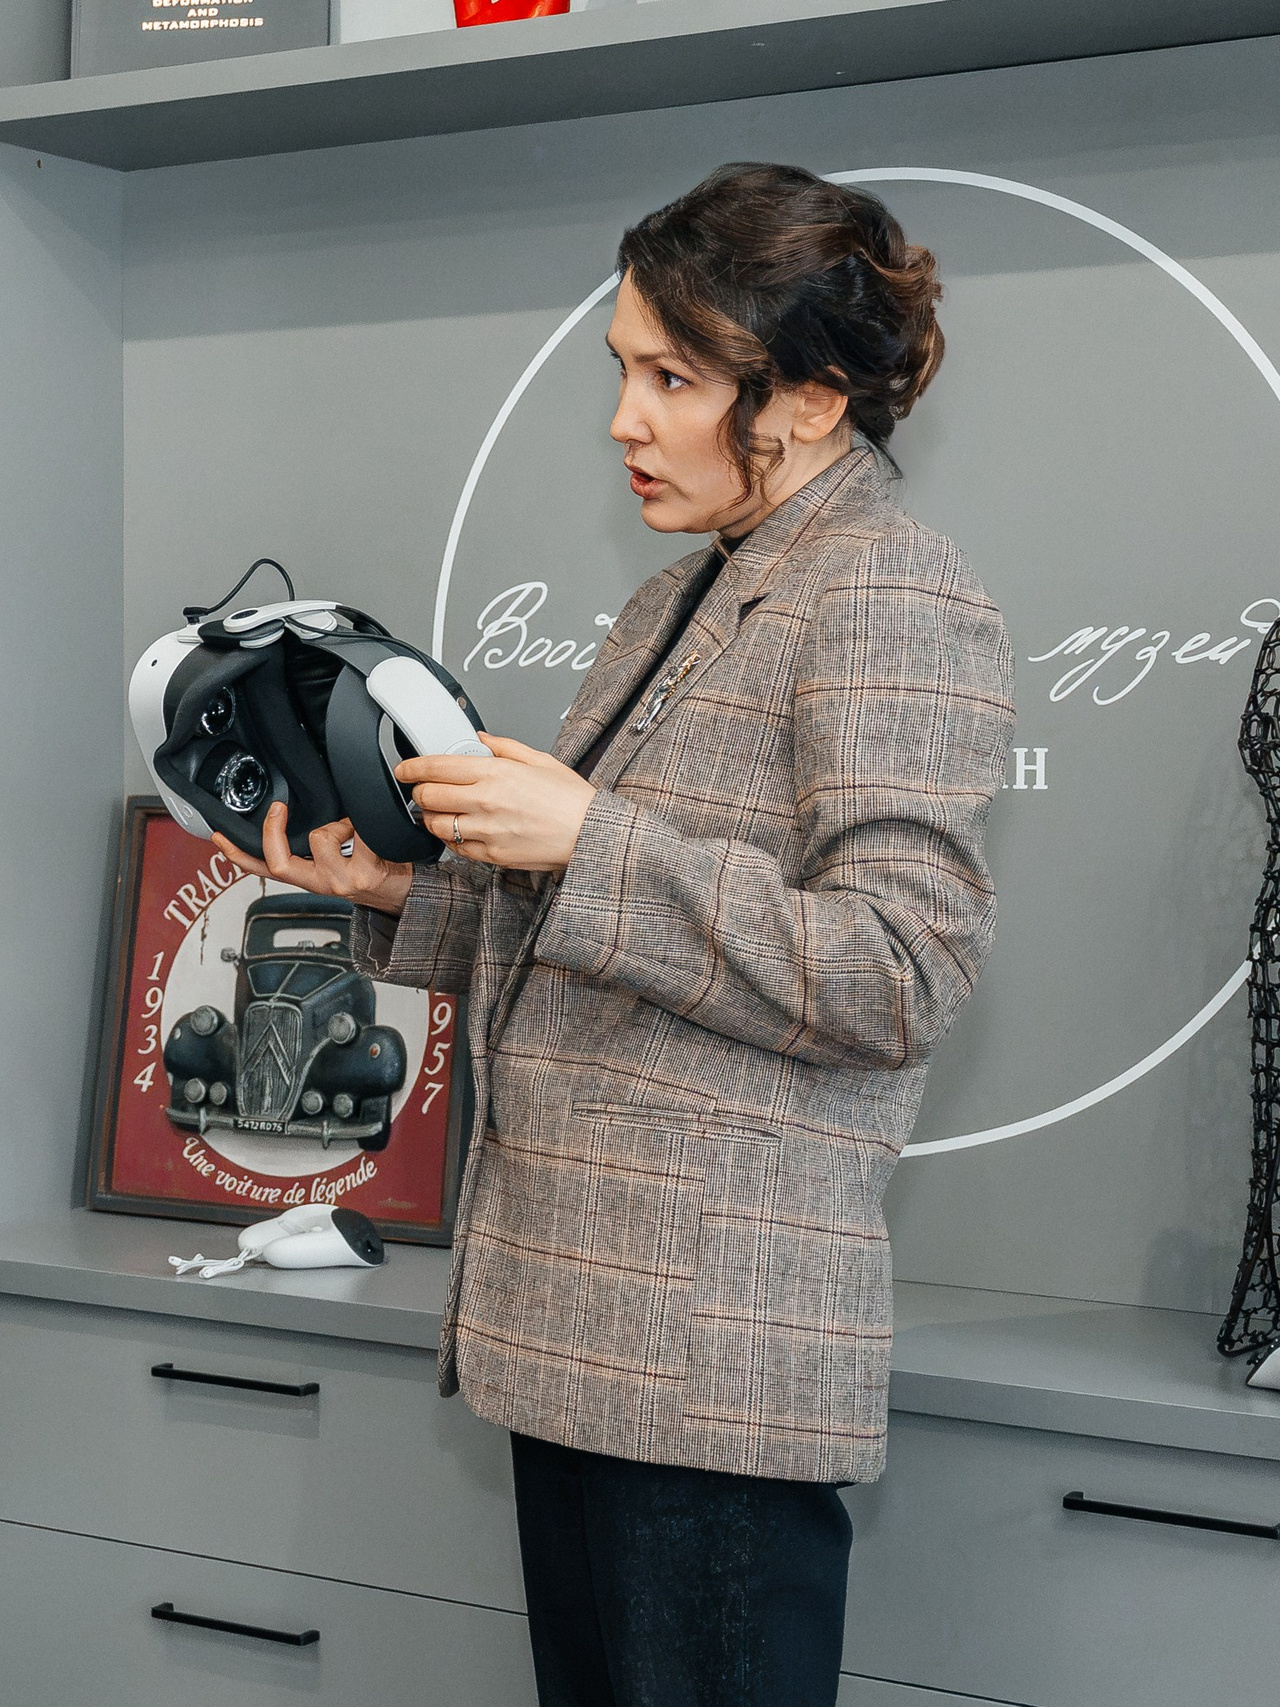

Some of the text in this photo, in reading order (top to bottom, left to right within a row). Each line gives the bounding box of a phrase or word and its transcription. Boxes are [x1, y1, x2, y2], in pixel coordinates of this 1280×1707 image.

[141, 17, 264, 31] METAMORPHOSIS
[187, 8, 219, 17] AND
[421, 991, 453, 1115] 957
[181, 1136, 378, 1205] Une voiture de légende
